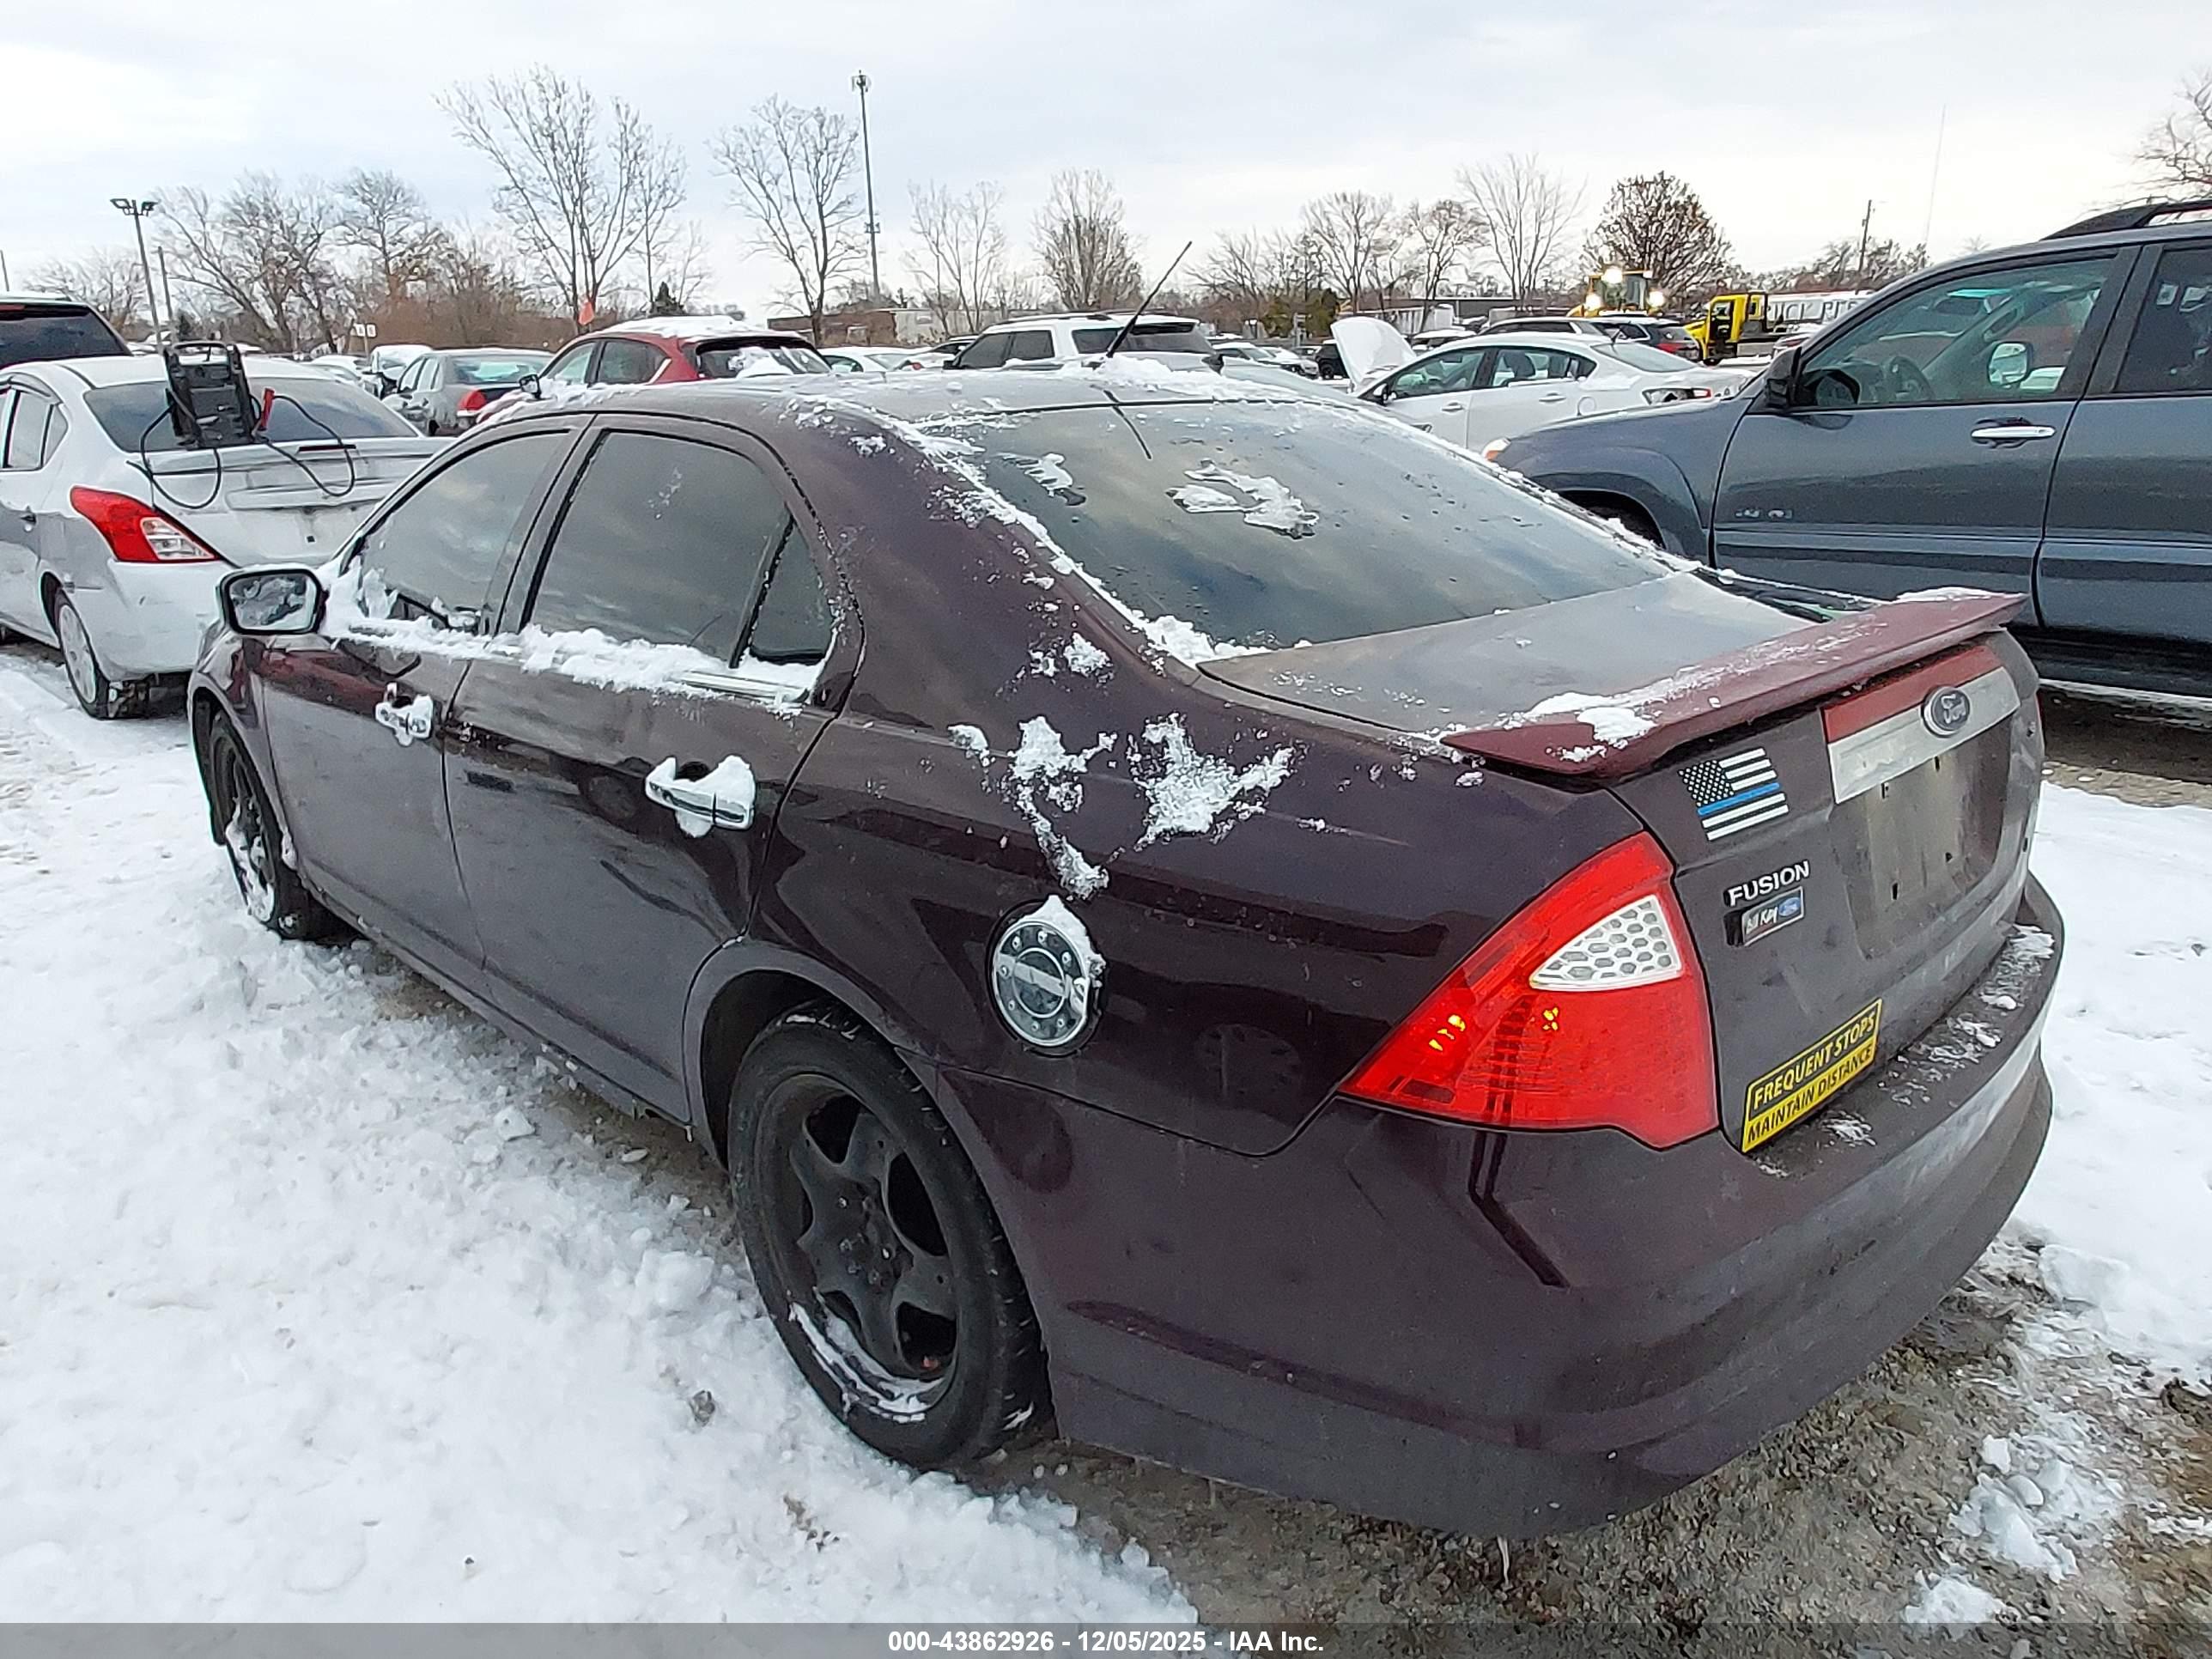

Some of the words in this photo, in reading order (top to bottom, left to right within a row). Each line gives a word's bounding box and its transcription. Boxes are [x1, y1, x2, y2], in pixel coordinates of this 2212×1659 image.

[1728, 860, 1809, 907] FUSION
[1747, 1087, 1815, 1144] MAINTAIN
[1818, 1043, 1872, 1095] DISTANCE
[1753, 1042, 1834, 1110] FREQUENT
[1834, 1011, 1875, 1057] STOPS
